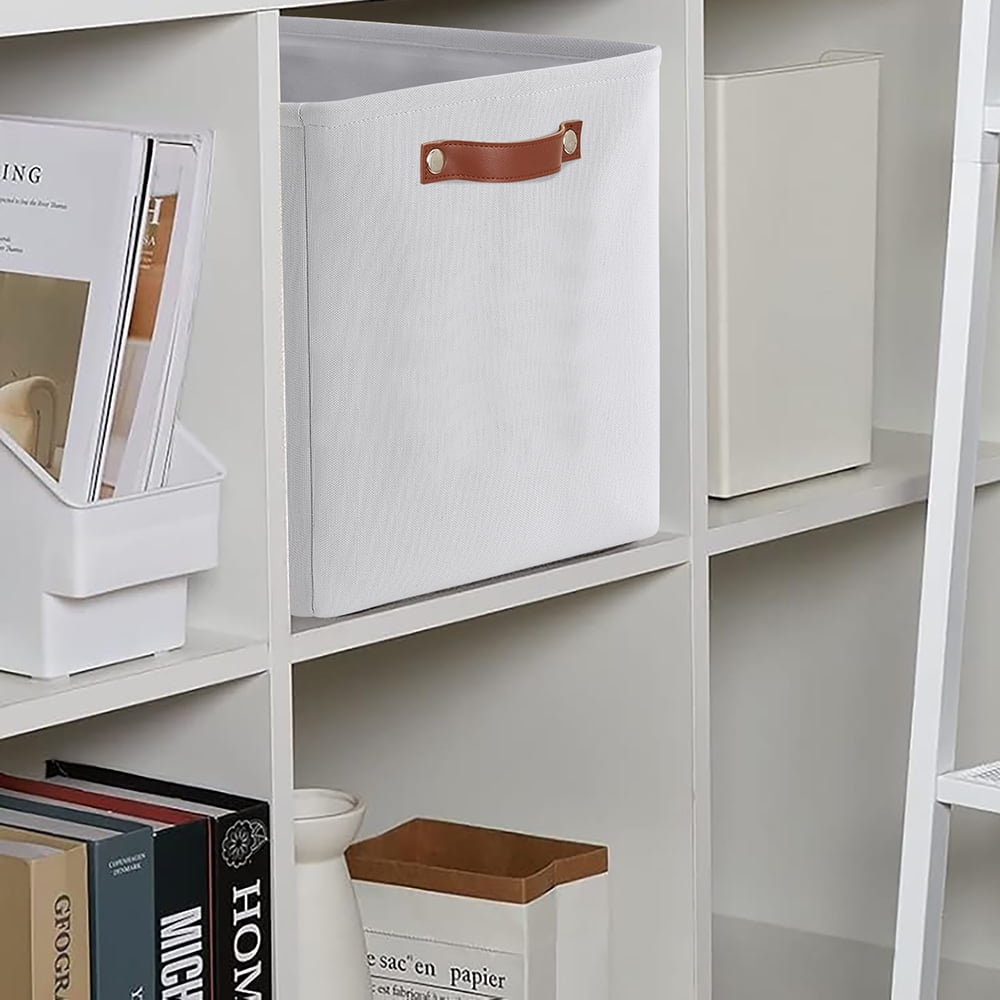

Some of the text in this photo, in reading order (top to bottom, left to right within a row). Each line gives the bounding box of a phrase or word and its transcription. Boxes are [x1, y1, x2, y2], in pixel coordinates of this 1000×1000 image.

[2, 164, 42, 184] ING
[415, 961, 436, 977] en
[450, 967, 506, 990] papier
